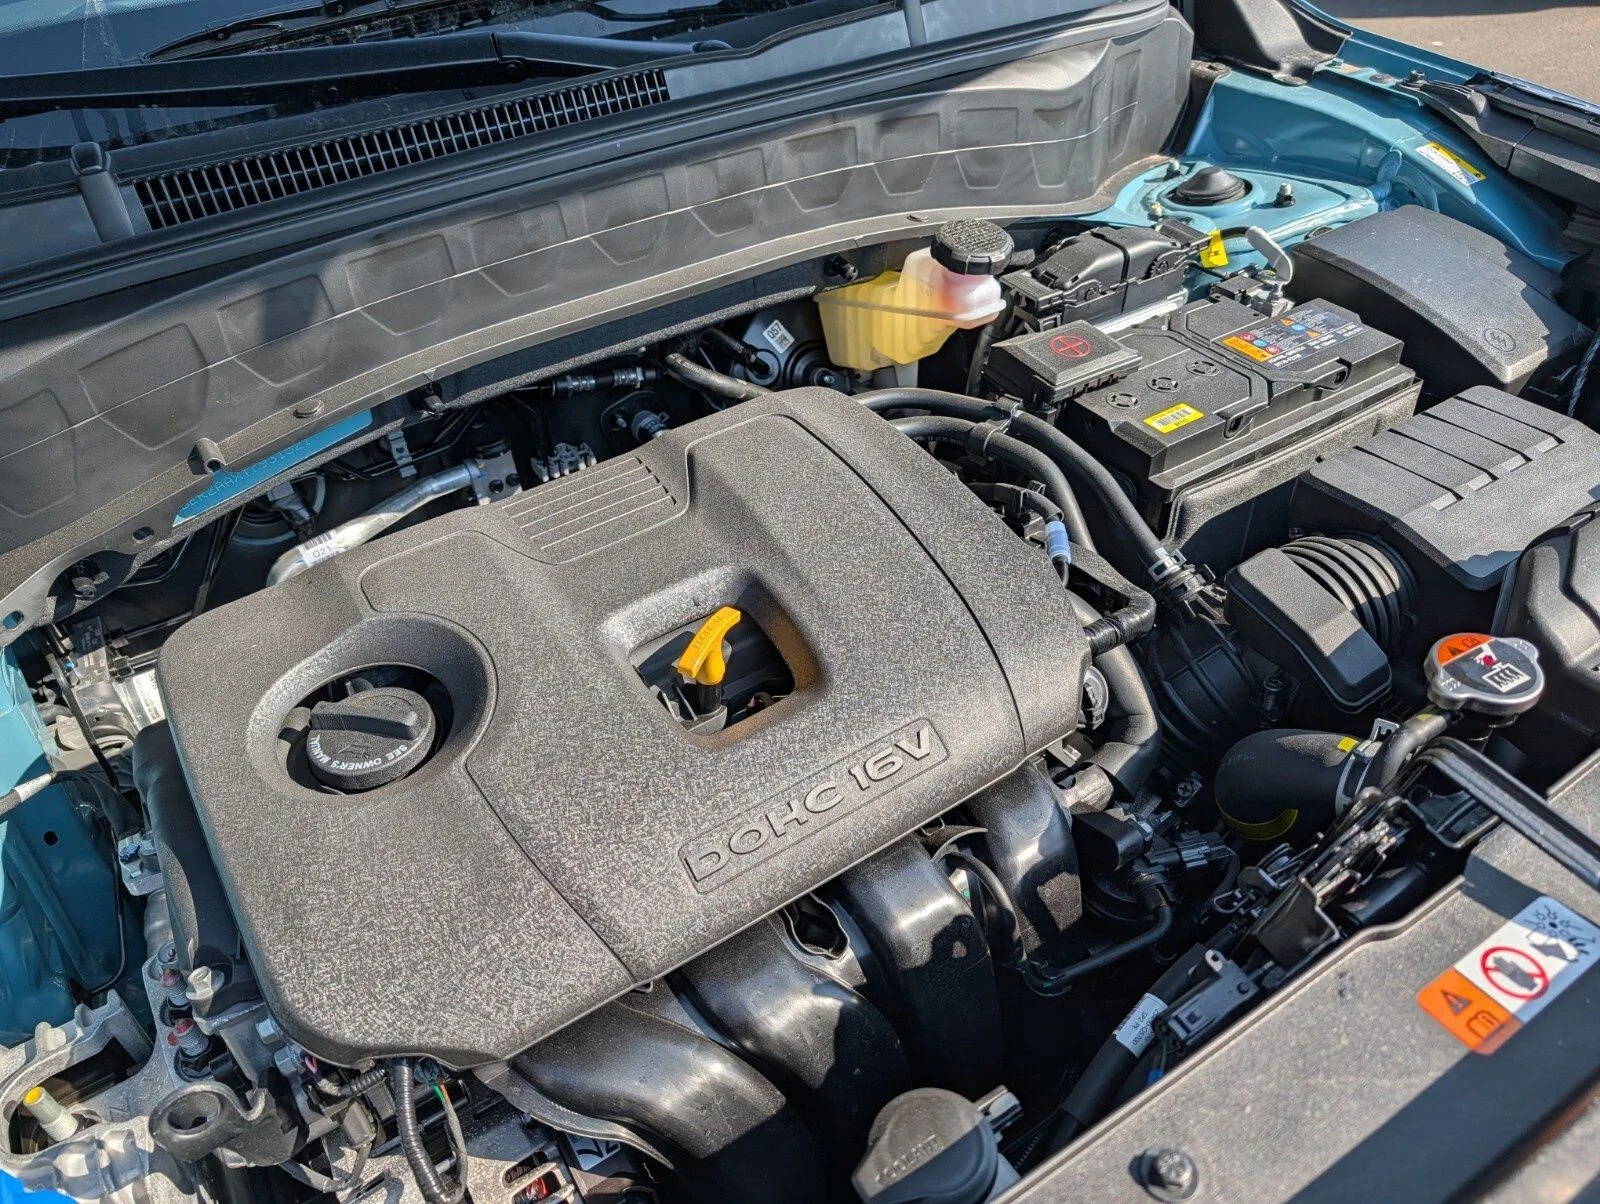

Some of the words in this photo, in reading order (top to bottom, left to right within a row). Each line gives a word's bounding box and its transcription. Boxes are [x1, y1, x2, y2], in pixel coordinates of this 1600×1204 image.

[310, 734, 331, 765] MANUAL
[386, 744, 408, 761] SEE
[331, 757, 382, 771] OWNER'S
[683, 780, 845, 882] DOHC
[848, 727, 931, 791] 16V
